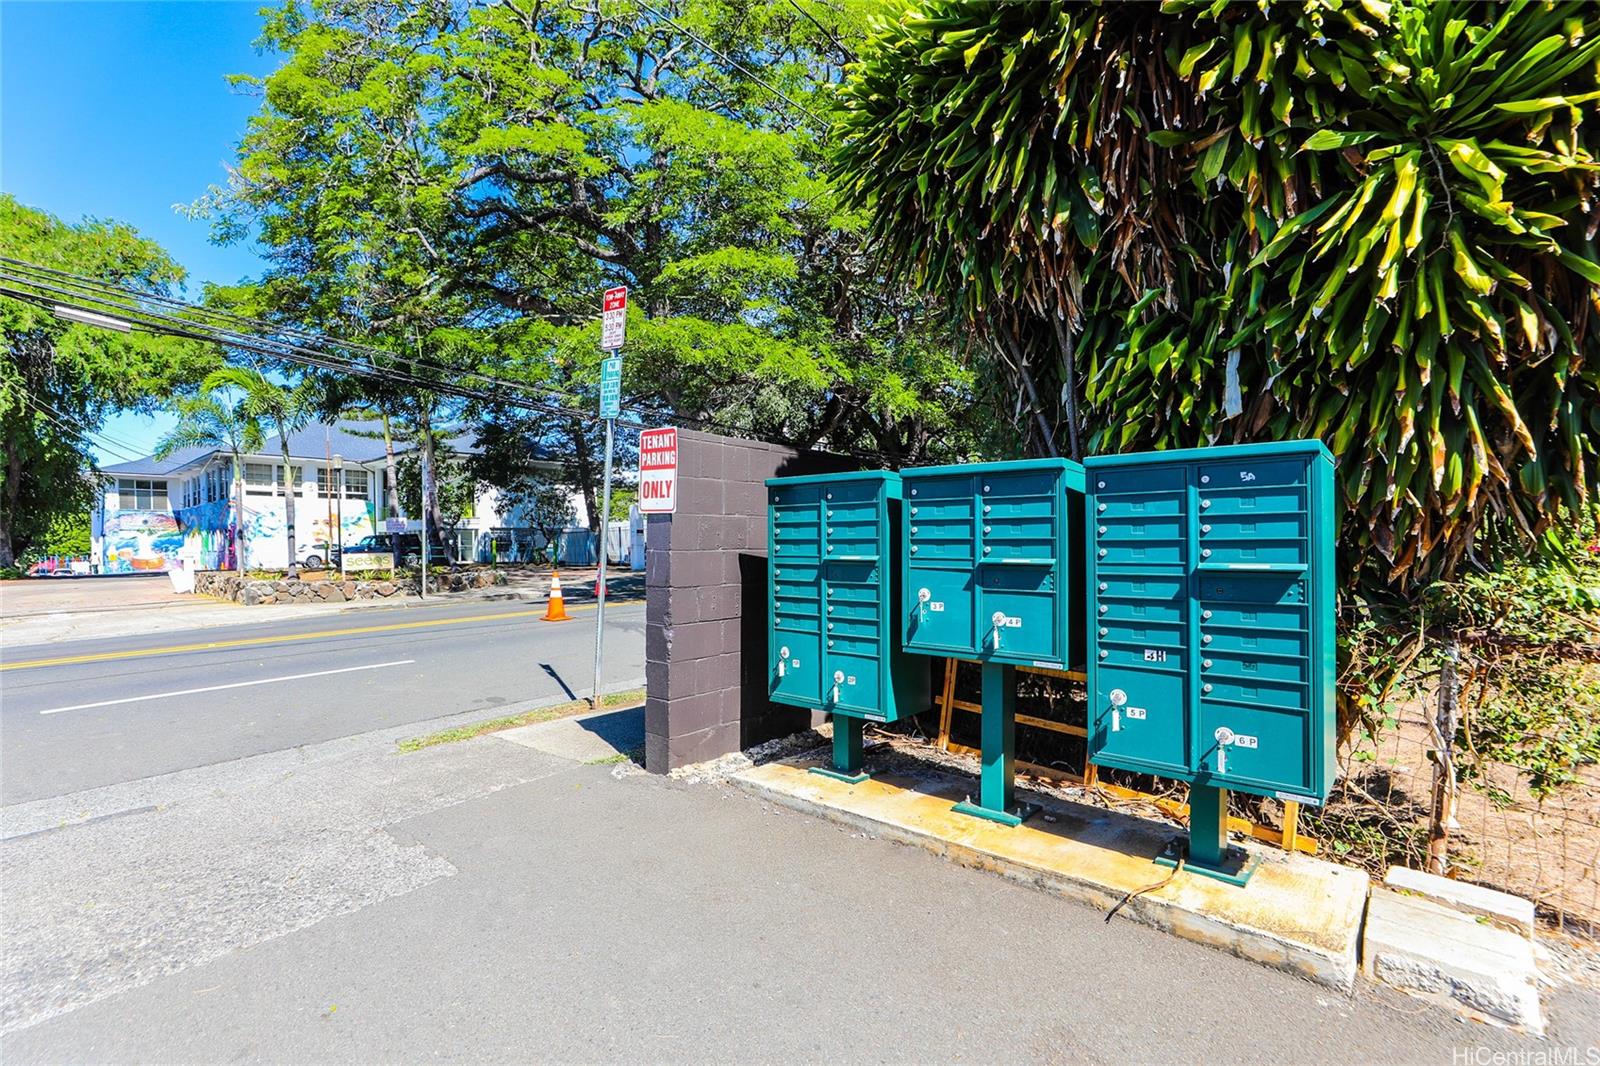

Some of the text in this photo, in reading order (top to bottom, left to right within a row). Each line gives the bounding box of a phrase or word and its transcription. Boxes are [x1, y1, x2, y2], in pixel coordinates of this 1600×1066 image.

[642, 433, 675, 450] TENANT
[642, 450, 675, 466] PARKING
[643, 480, 673, 499] ONLY
[1239, 737, 1256, 746] 6 P
